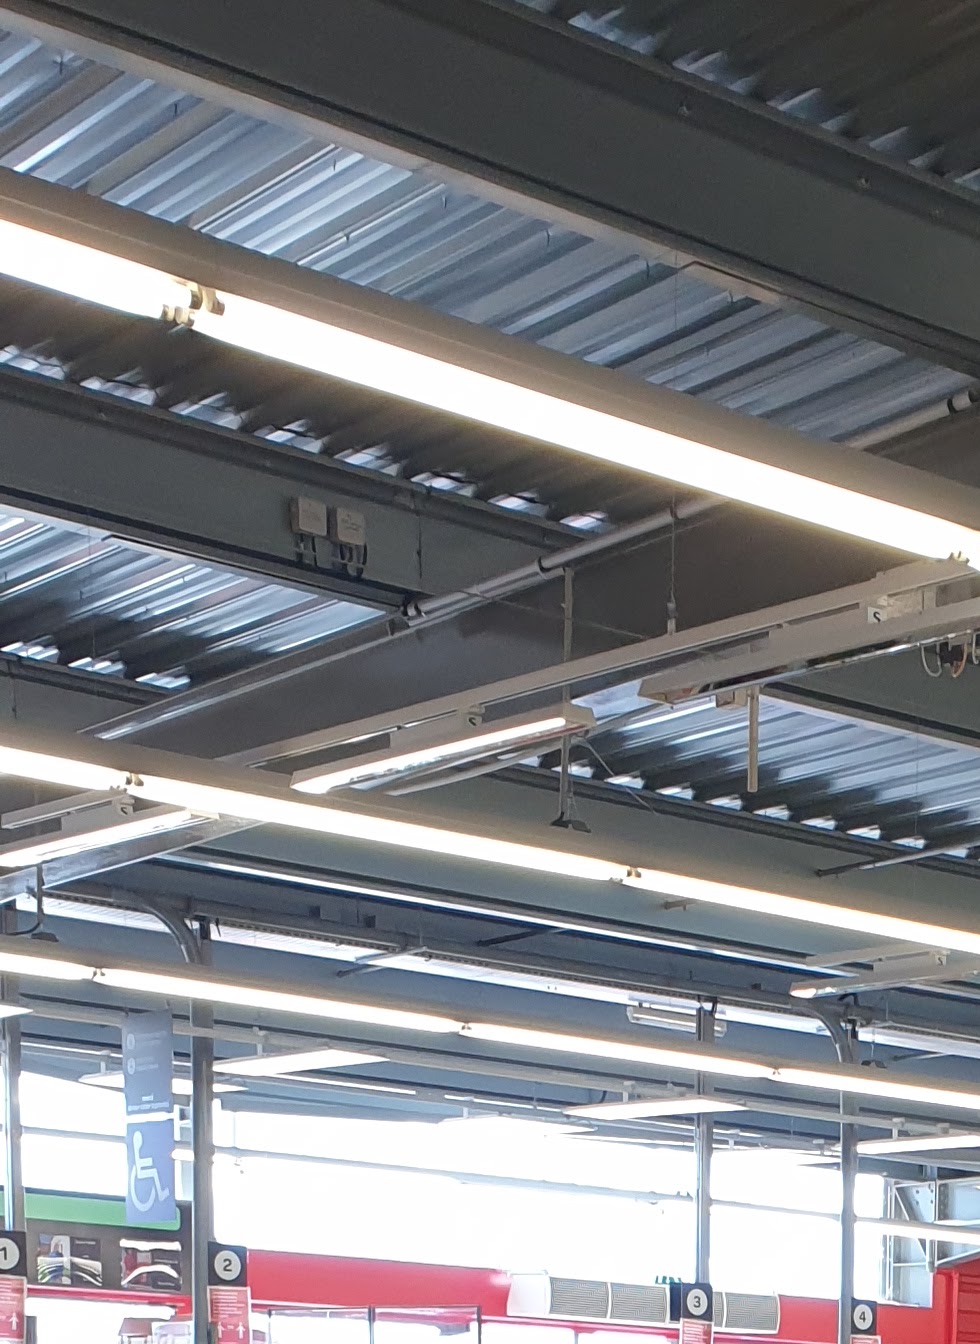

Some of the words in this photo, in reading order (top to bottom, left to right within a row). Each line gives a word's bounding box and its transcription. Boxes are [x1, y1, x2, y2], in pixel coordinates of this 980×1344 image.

[1, 1246, 8, 1260] 1
[222, 1258, 233, 1272] 2
[693, 1296, 701, 1309] 3
[858, 1310, 867, 1323] 4
